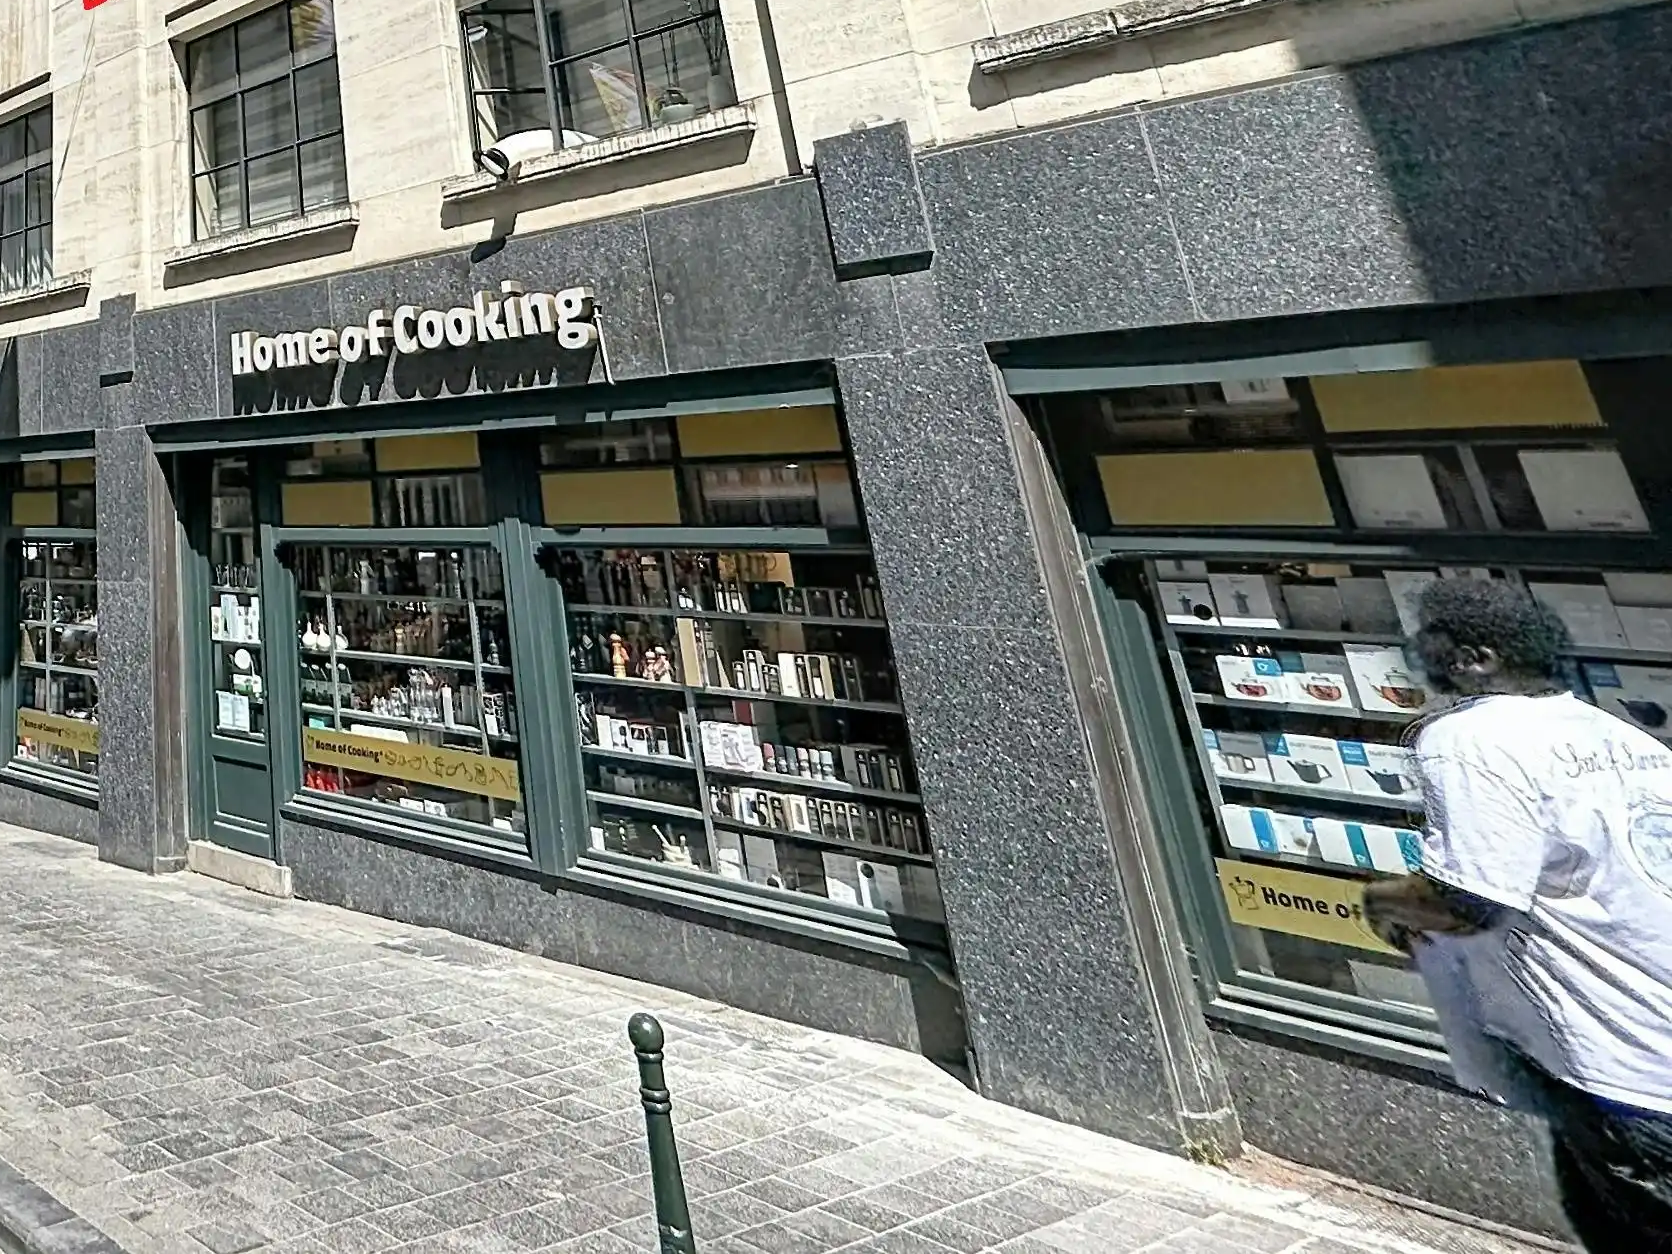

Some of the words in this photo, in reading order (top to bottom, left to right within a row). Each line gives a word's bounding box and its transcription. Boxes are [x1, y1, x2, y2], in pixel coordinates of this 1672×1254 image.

[232, 326, 338, 375] Home
[337, 309, 394, 362] of
[393, 280, 595, 354] Cooking
[315, 740, 337, 752] Home
[337, 744, 348, 755] of
[1261, 886, 1329, 915] Home
